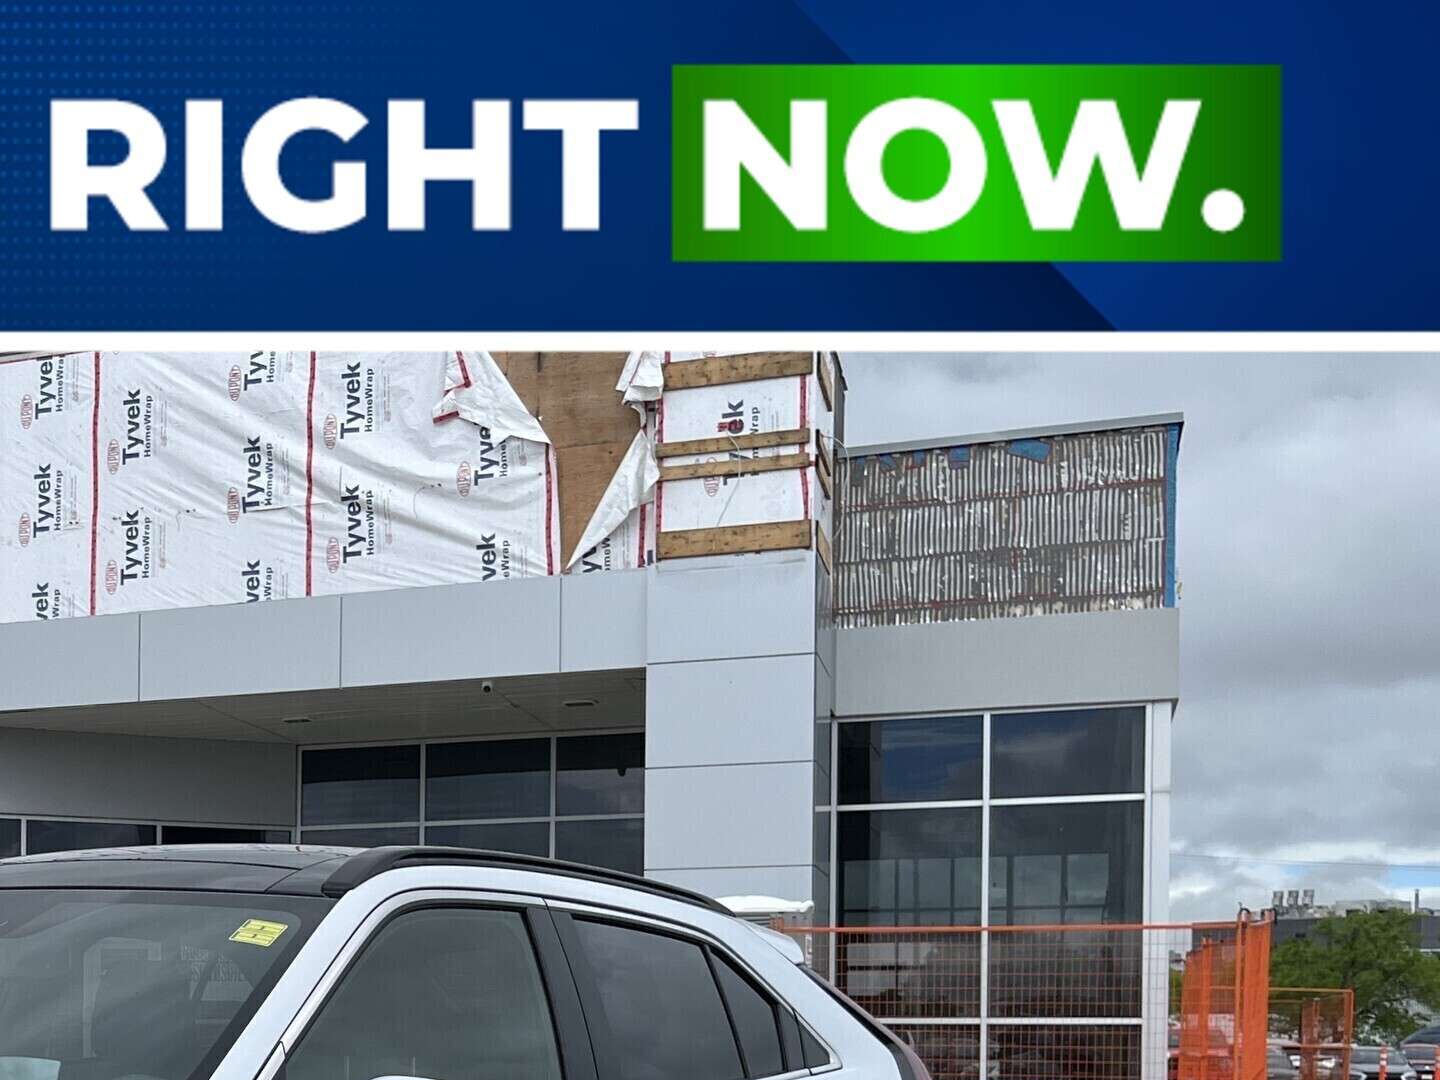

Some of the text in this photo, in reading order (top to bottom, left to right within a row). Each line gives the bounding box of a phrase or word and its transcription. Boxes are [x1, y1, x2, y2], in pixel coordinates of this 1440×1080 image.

[122, 389, 144, 465] Tyvek
[144, 395, 153, 457] HomeWrap
[340, 362, 365, 439] Tyvek
[365, 368, 375, 432] HomeWrap
[242, 436, 264, 513] Tyvek
[474, 426, 500, 486] Tyve
[33, 464, 54, 538] Tyvek
[54, 470, 63, 531] HomeWrap
[341, 485, 366, 563] Tyvek
[121, 510, 142, 585] Tyvek
[142, 517, 152, 578] HomeWrap
[476, 533, 496, 581] vek
[242, 560, 260, 603] vek
